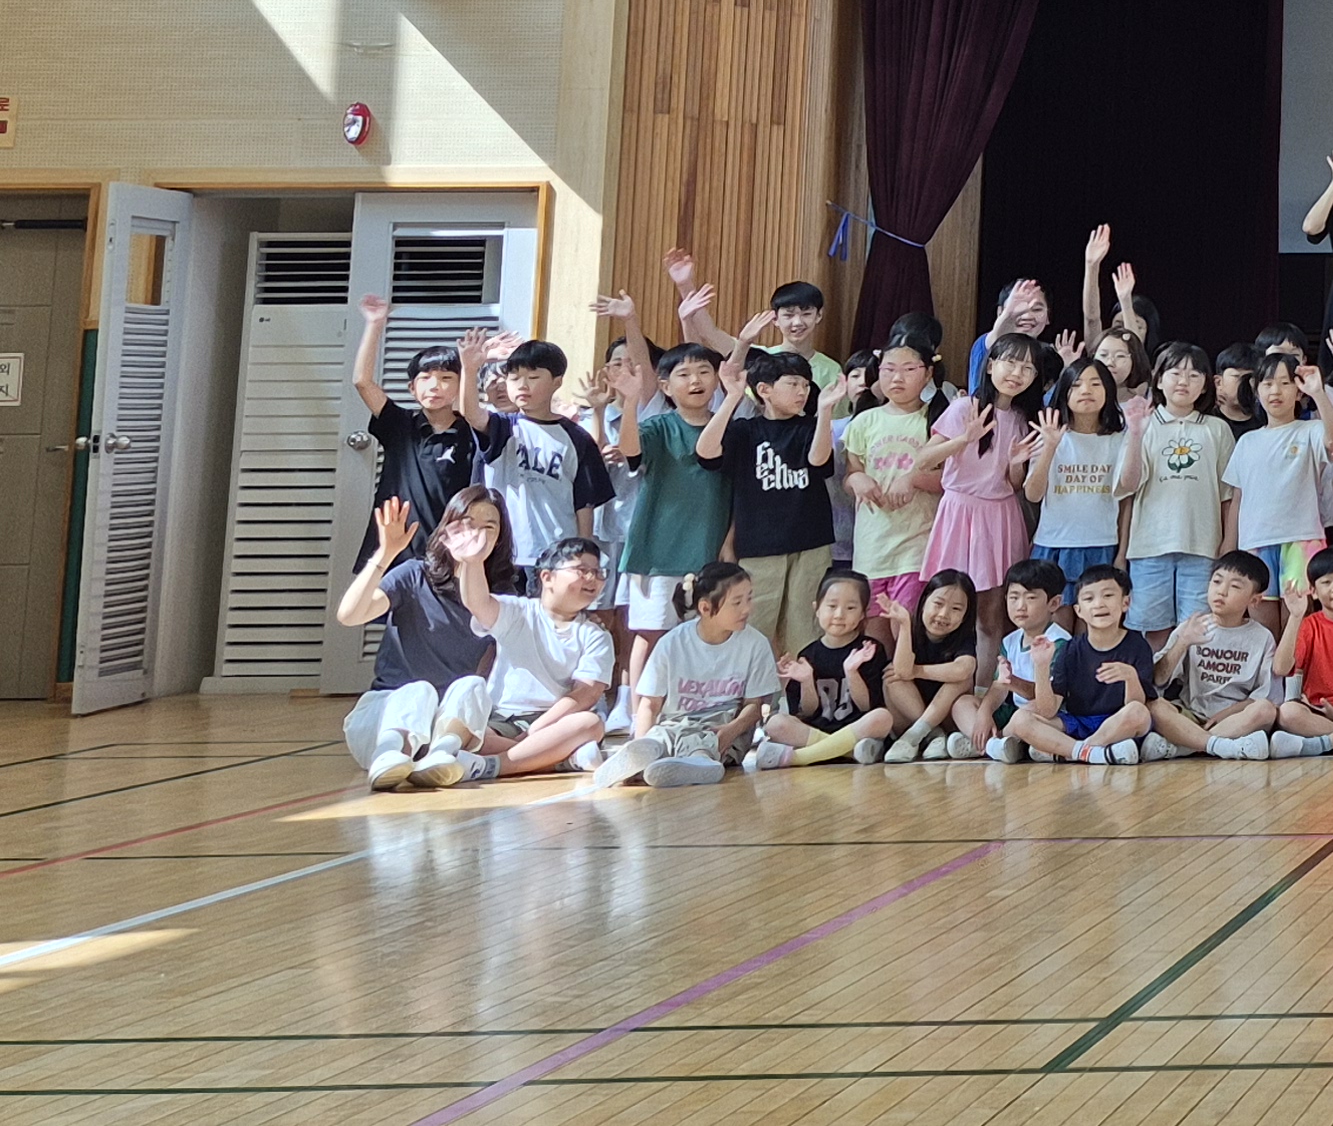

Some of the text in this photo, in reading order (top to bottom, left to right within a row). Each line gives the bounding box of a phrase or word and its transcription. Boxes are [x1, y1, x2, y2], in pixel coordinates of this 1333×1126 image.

[1057, 464, 1113, 474] SMILE DAY
[1065, 474, 1105, 484] DAY OF
[1196, 645, 1250, 662] BONJOUR
[1197, 659, 1242, 675] AMOUR
